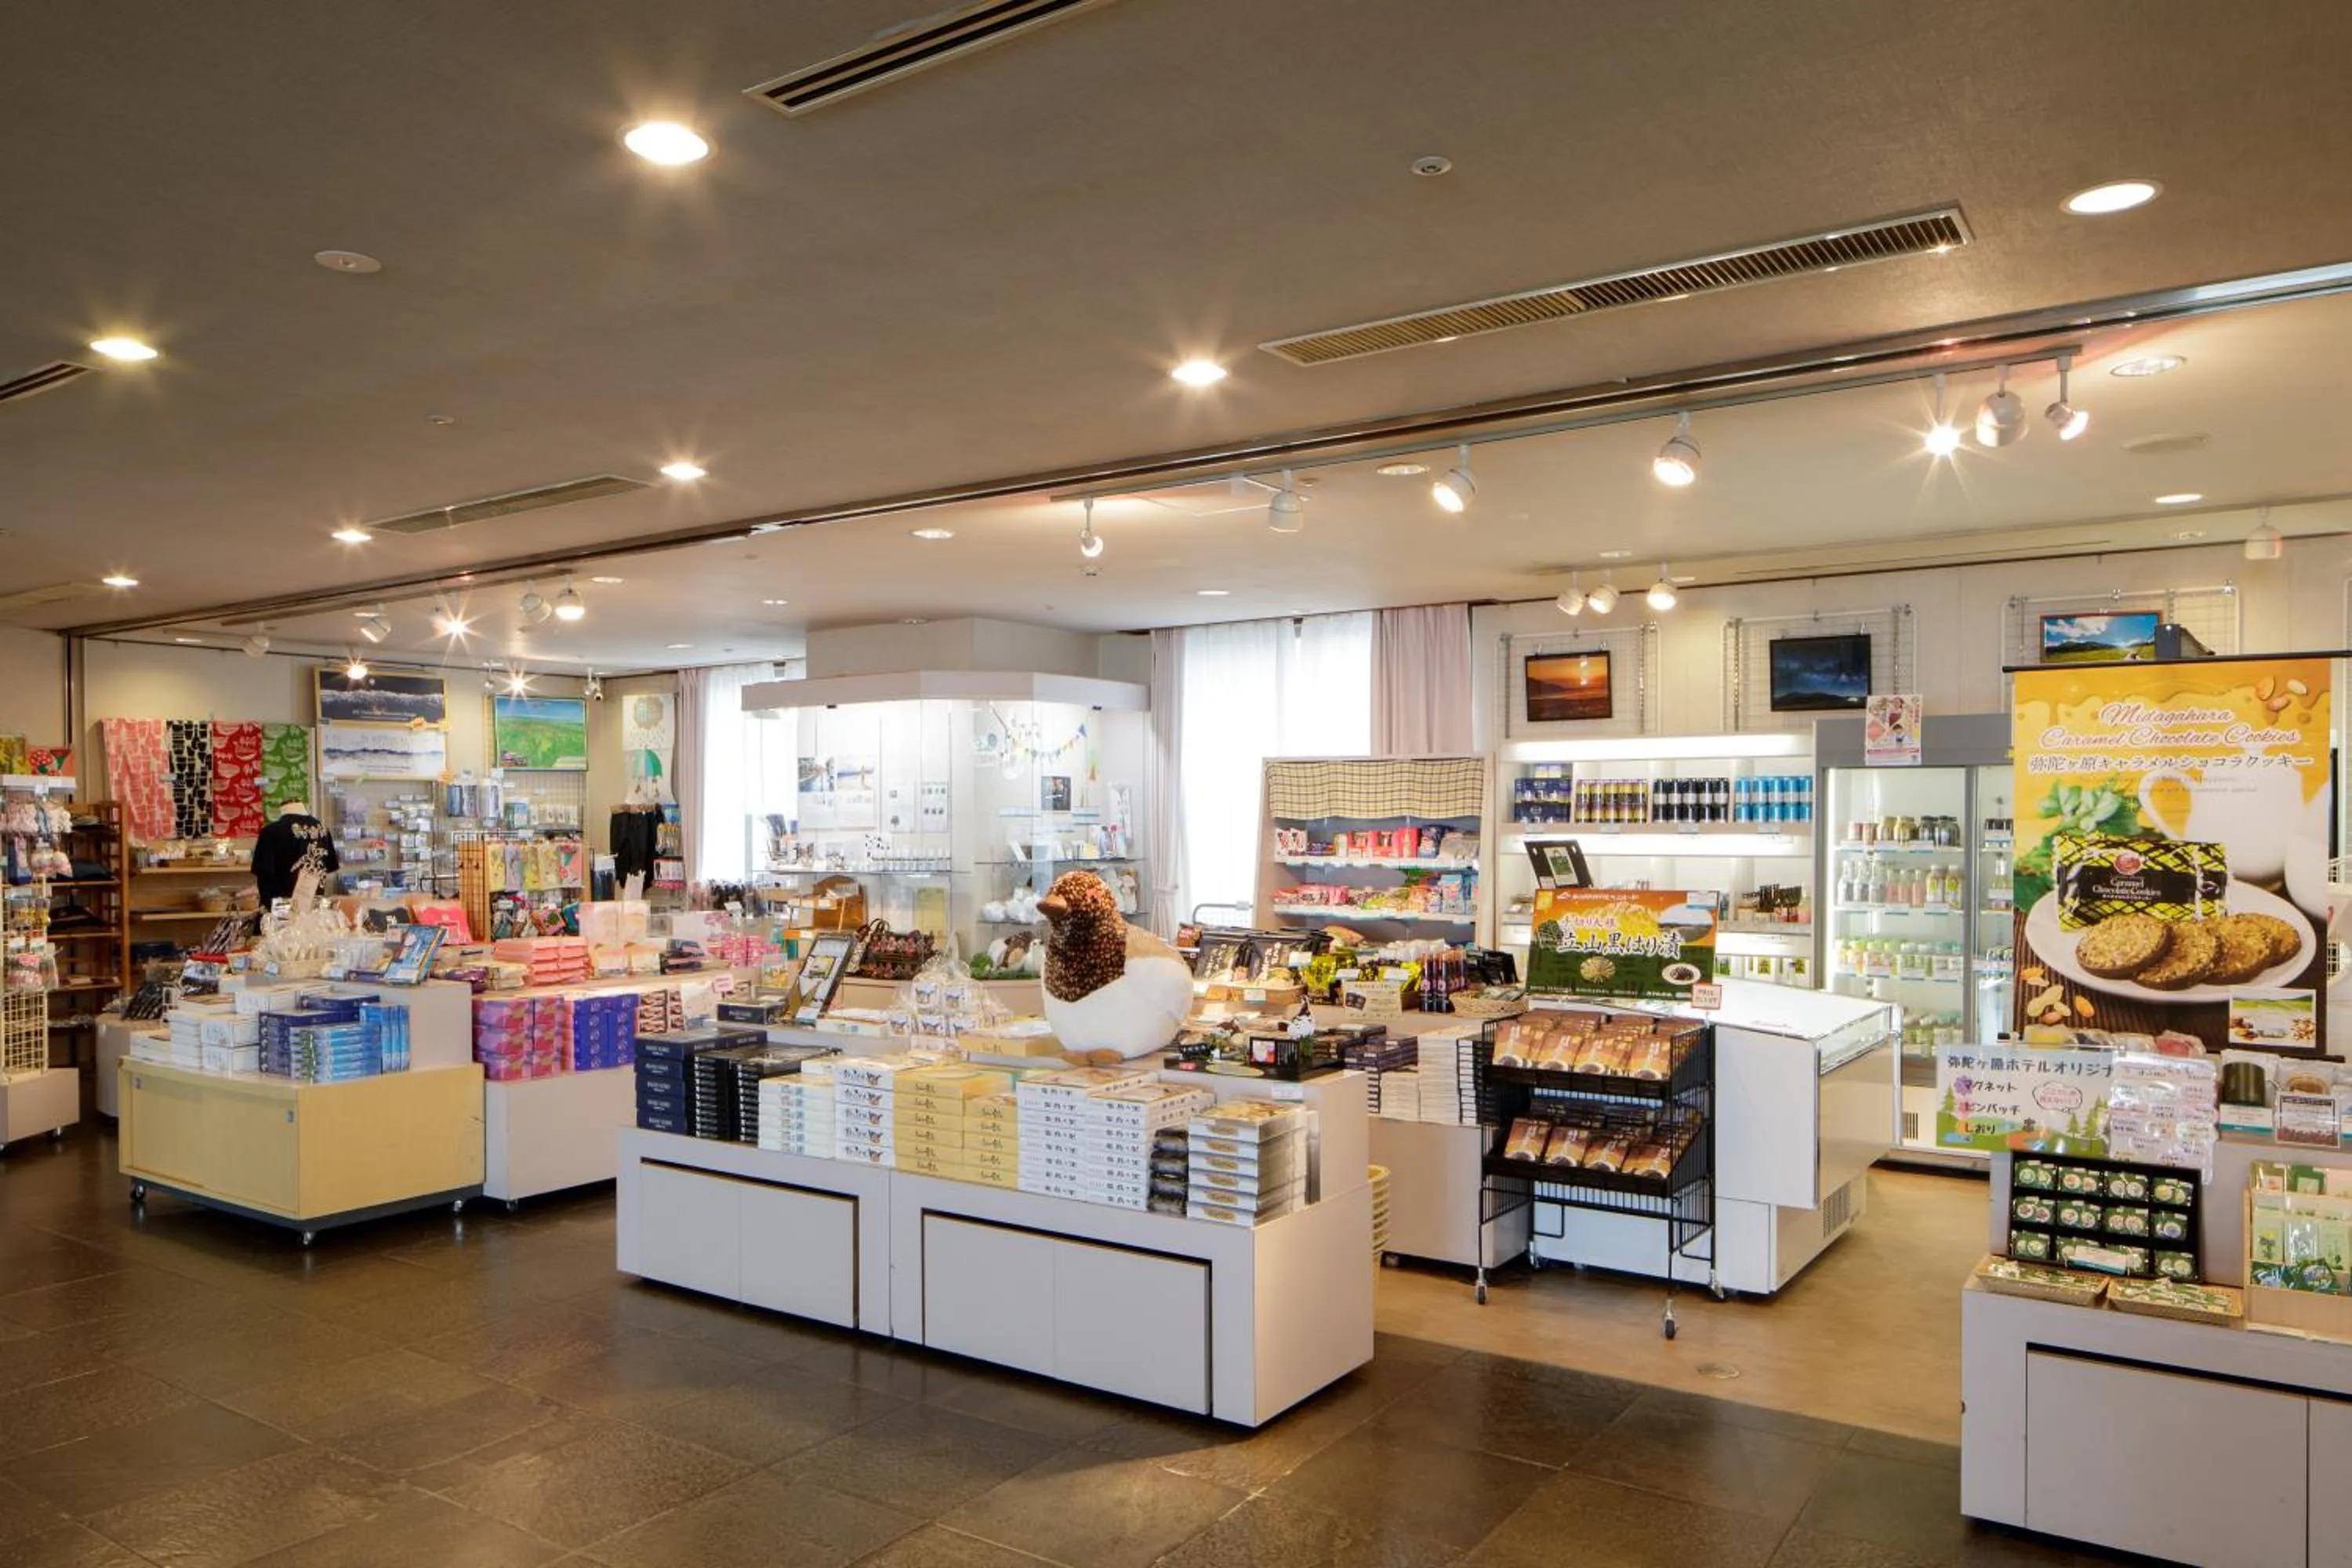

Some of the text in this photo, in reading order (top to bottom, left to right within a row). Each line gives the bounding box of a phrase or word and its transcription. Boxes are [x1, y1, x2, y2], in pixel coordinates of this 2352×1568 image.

[2041, 724, 2298, 747] Caramel Chocolate Cookies
